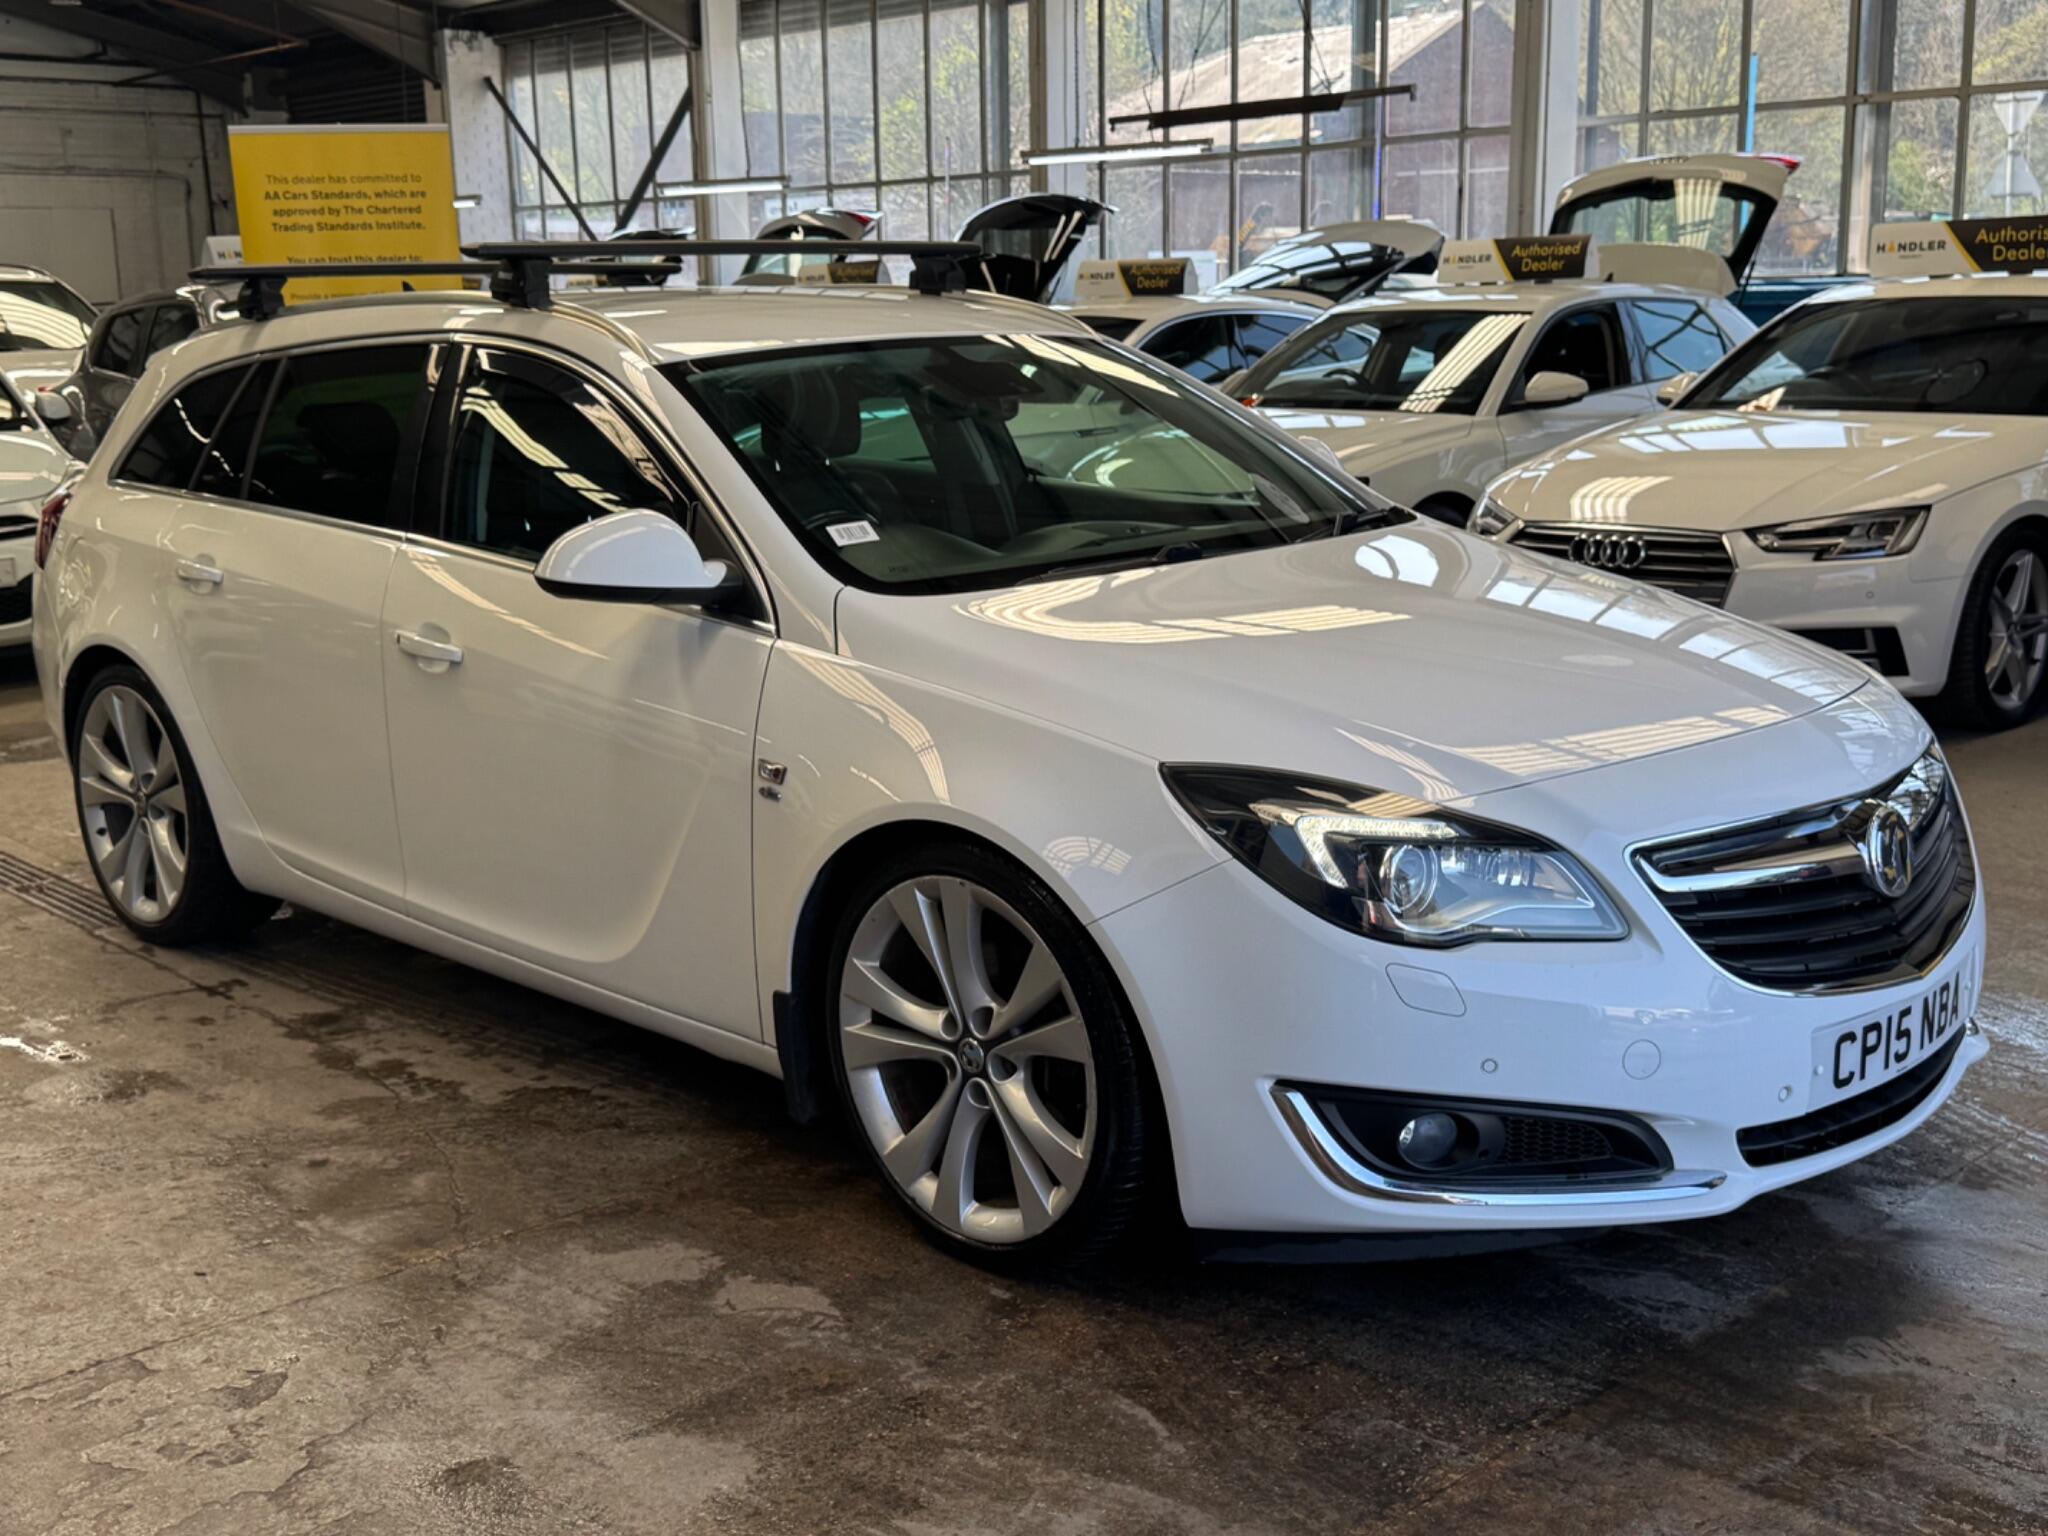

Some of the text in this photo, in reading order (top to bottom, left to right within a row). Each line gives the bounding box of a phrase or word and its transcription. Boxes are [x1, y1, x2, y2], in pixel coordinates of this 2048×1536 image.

[265, 173, 422, 184] This dealer has committed to
[264, 189, 427, 200] AA Cars Standards, which are
[272, 205, 422, 217] approved by The Chartered
[272, 220, 426, 233] Trading Standards Institute.
[1511, 240, 1582, 258] Authorised
[1877, 239, 1946, 255] HANDLER
[1993, 244, 2048, 262] Deale
[286, 256, 305, 265] You
[328, 255, 352, 264] trust
[354, 255, 375, 263] this
[376, 254, 406, 263] dealer
[1443, 253, 1491, 265] HANDLER
[1521, 257, 1564, 272] Dealer
[1130, 262, 1181, 276] Authorised
[1136, 275, 1169, 289] Dealer
[1832, 972, 1960, 1089] CP15 NBA
